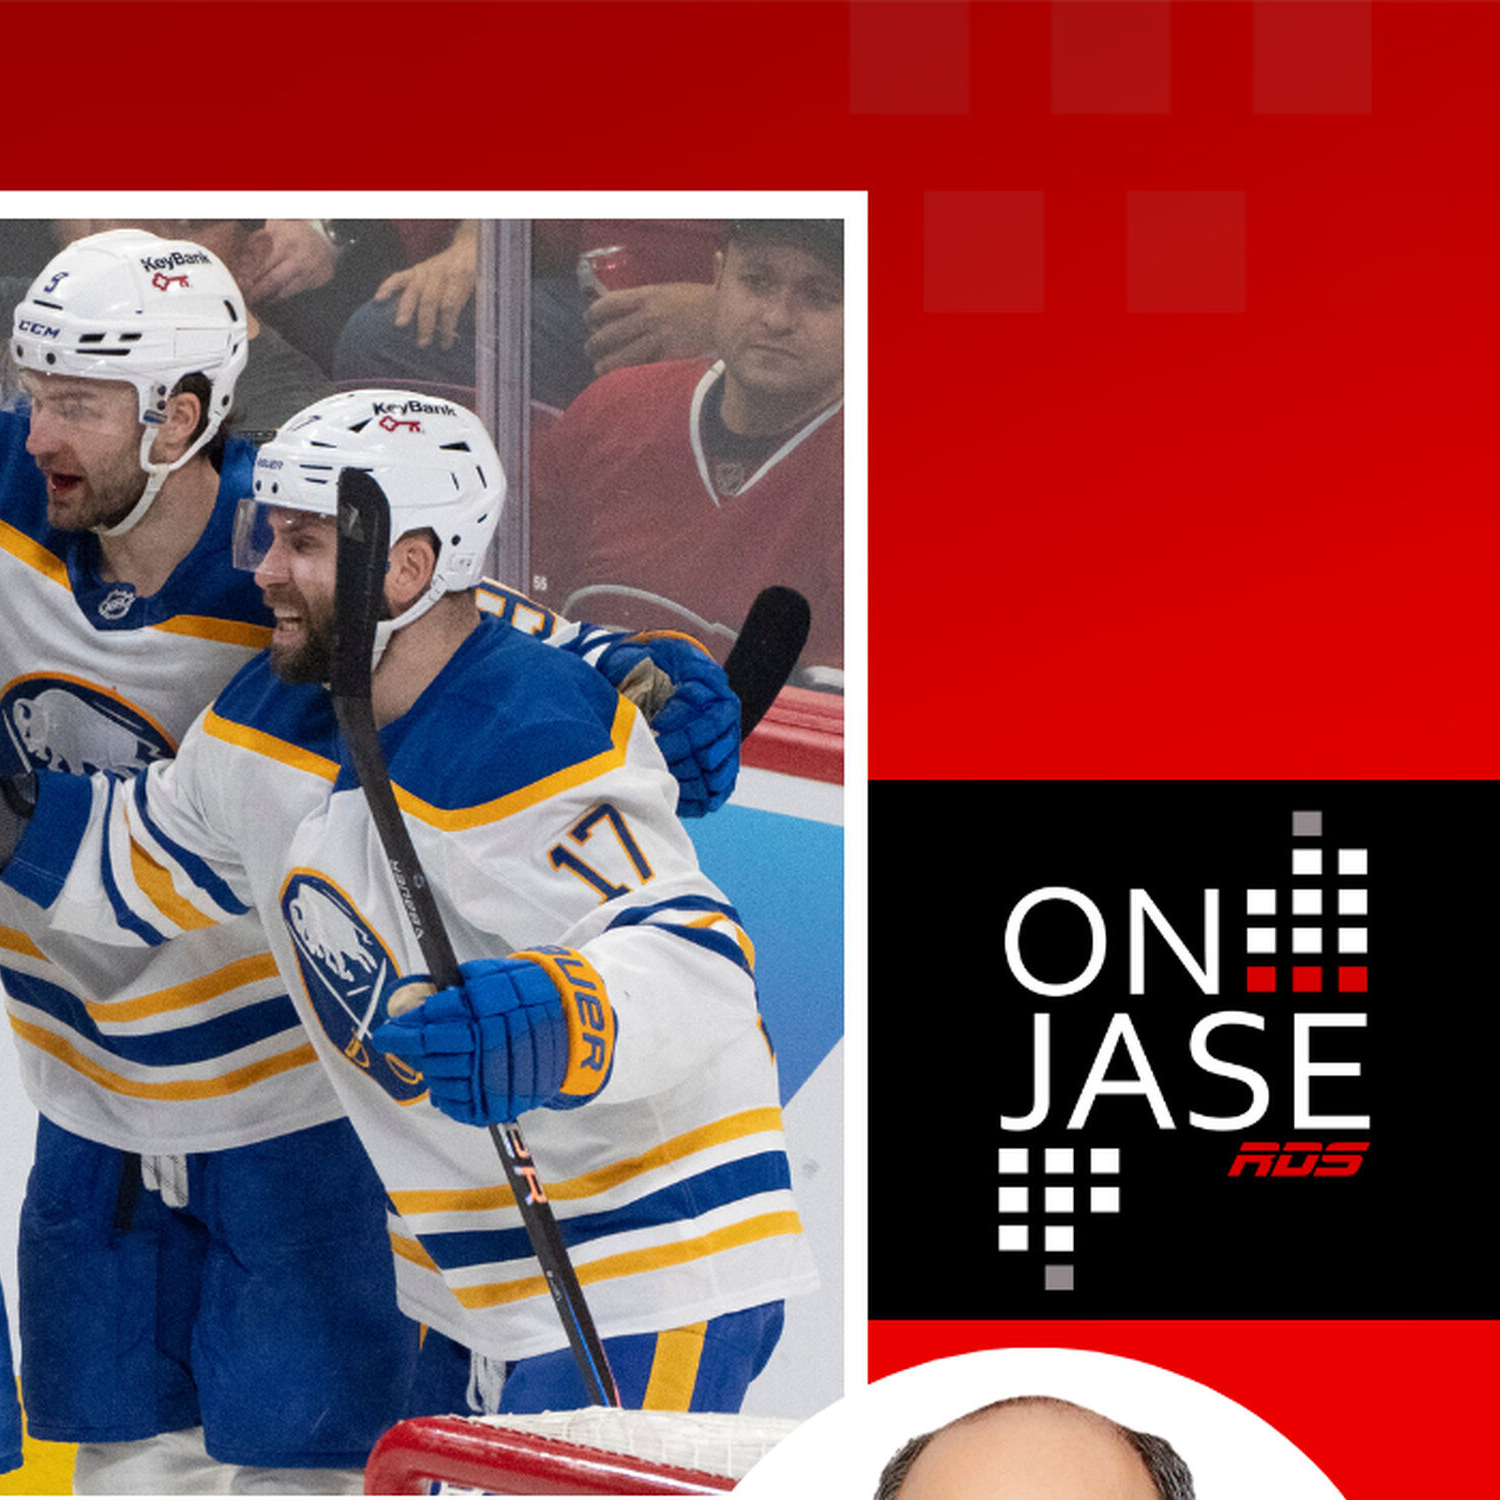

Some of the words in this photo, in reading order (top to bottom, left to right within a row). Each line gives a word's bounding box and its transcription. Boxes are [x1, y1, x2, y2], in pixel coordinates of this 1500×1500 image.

[141, 252, 212, 272] KeyBank
[18, 319, 62, 339] CCM
[372, 401, 457, 417] KeyBank
[548, 802, 656, 907] 17
